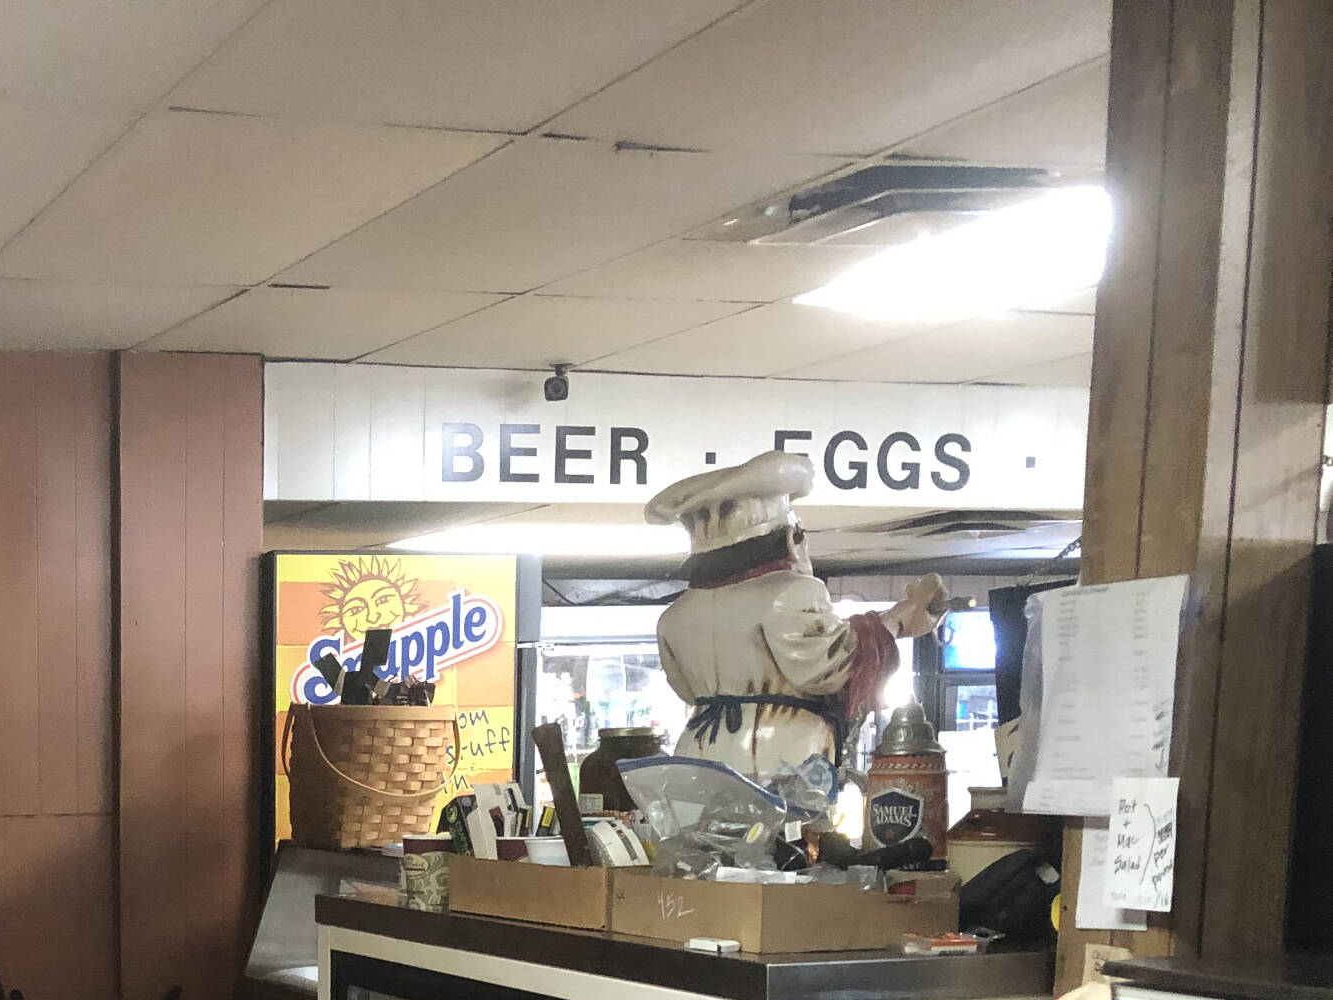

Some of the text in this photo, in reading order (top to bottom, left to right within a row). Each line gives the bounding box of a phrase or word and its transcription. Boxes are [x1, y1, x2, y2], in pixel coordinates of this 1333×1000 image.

[441, 422, 650, 485] BEER
[872, 803, 917, 819] SAMUEL
[873, 814, 912, 827] ADAMS
